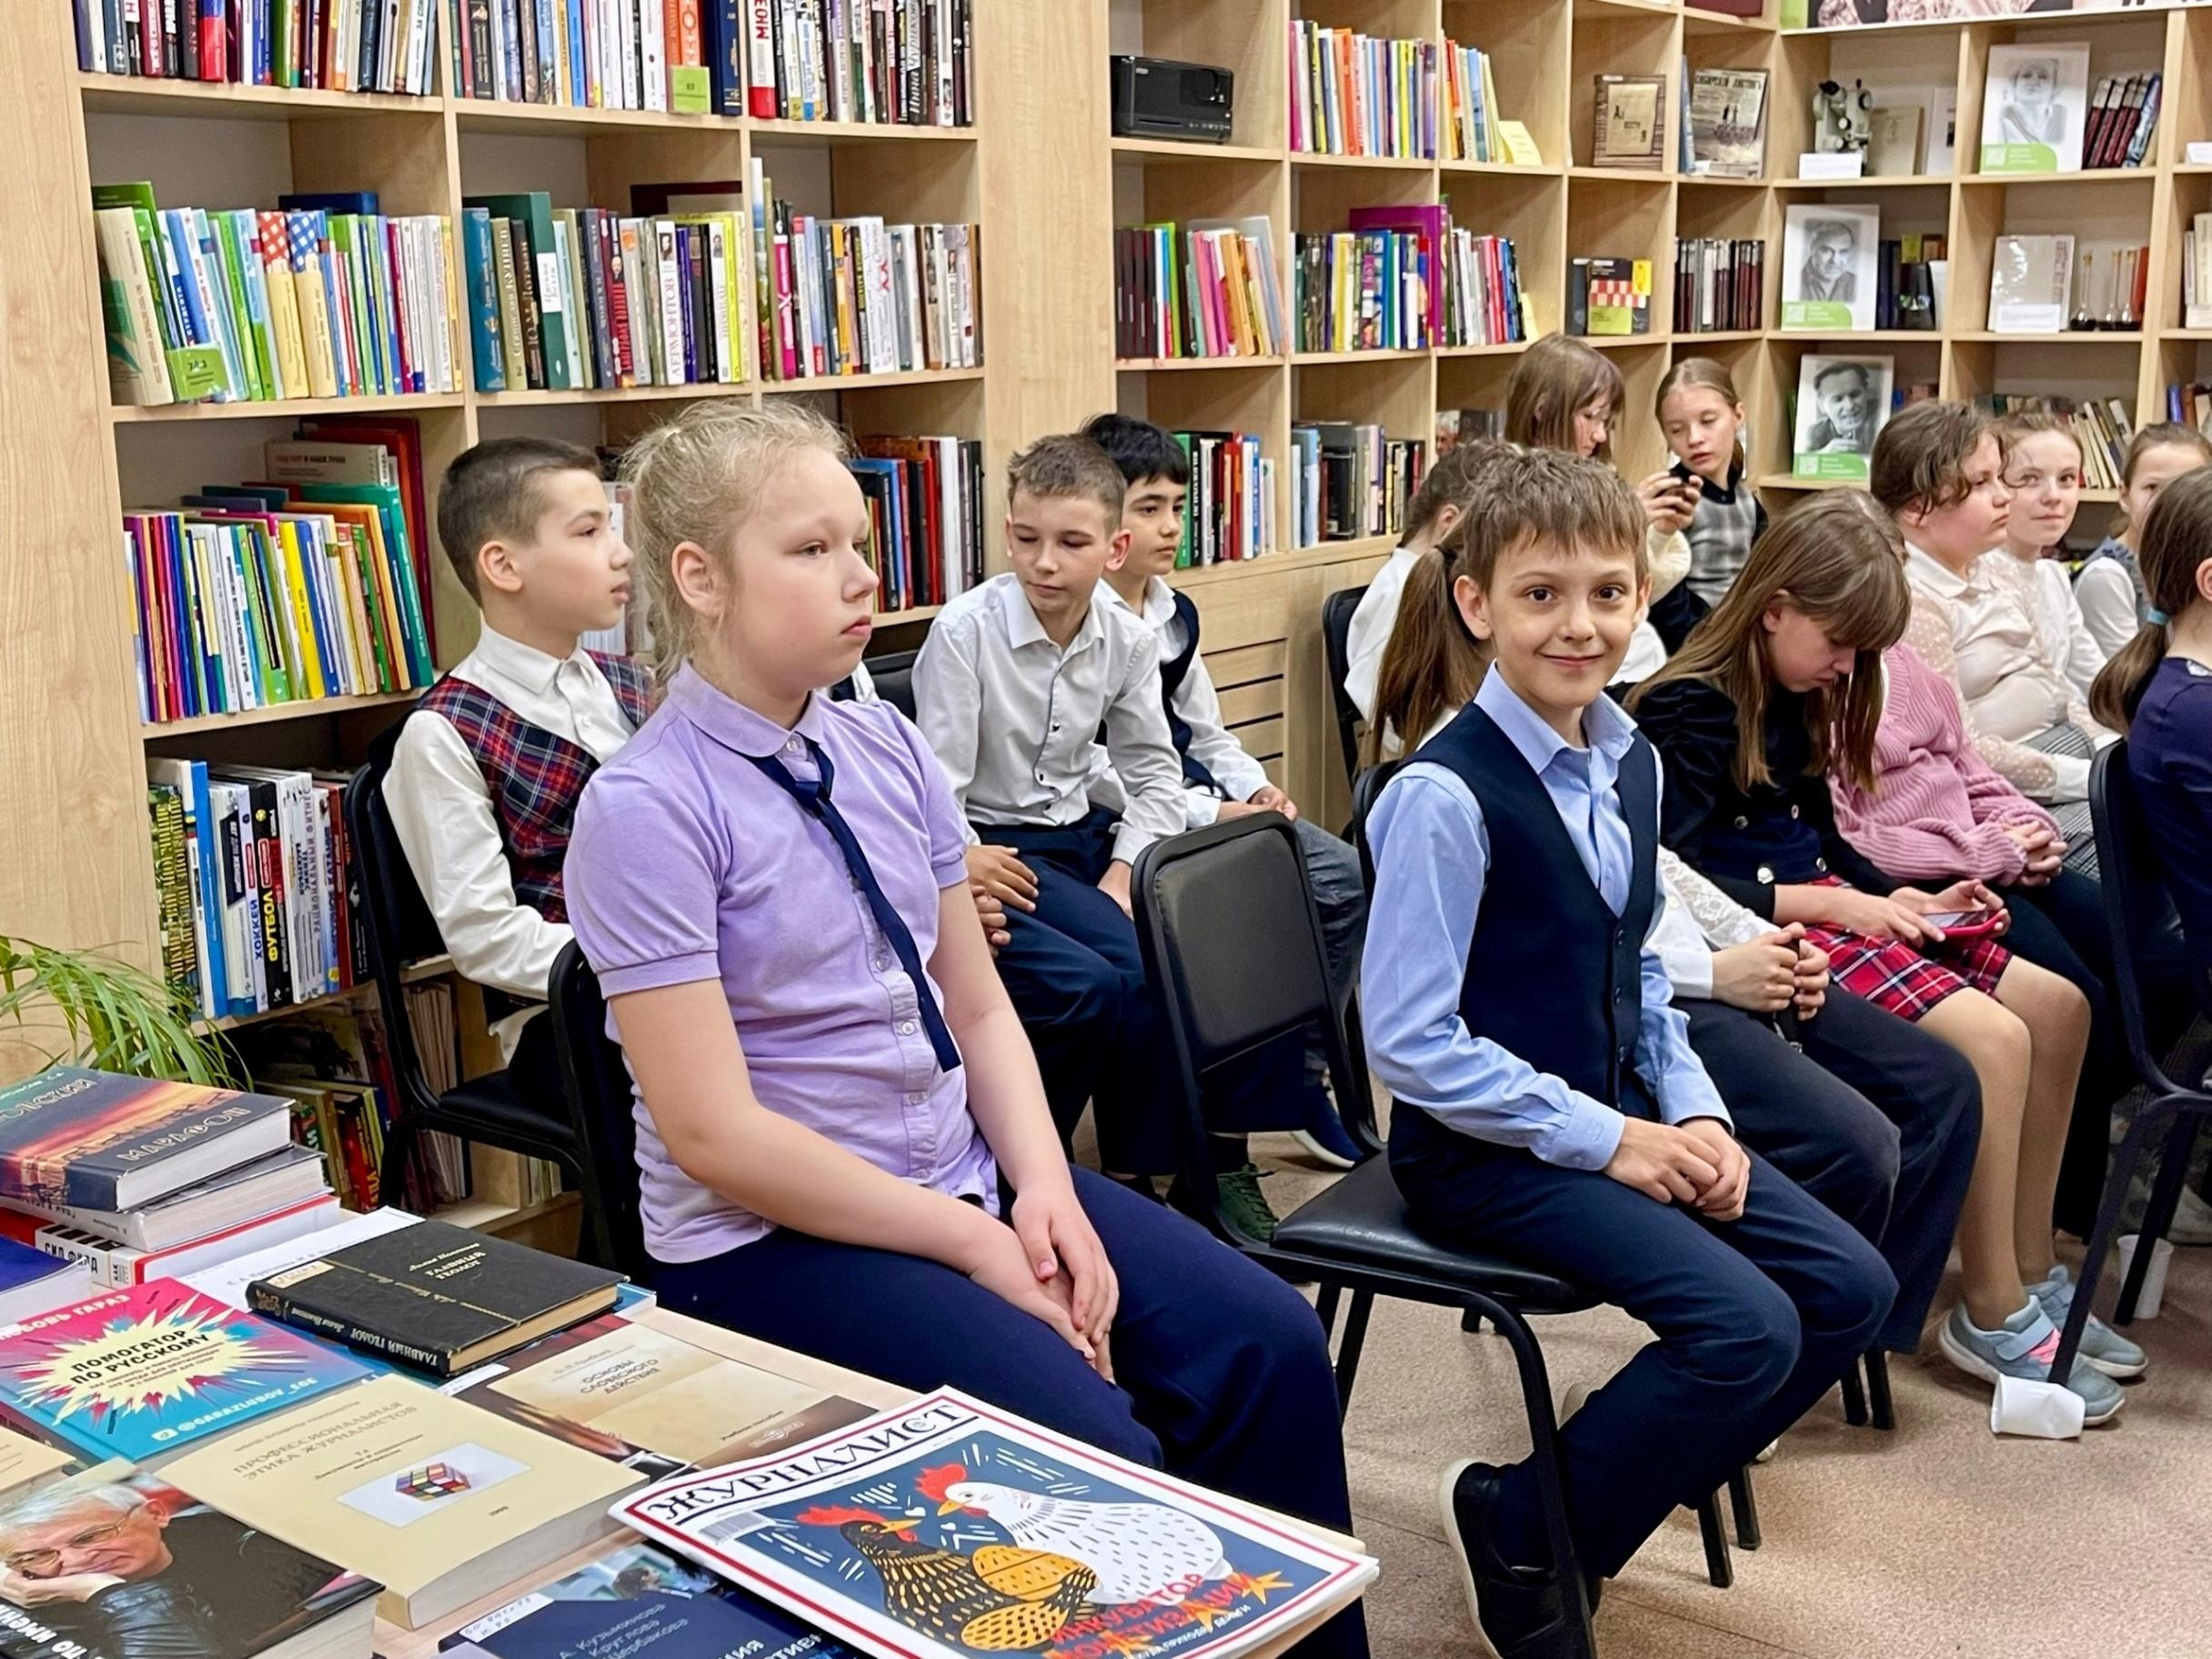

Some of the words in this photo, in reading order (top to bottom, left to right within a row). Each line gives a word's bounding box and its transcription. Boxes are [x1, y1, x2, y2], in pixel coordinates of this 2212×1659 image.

[662, 276, 683, 377] ЛЕРМОНТОВ
[516, 366, 523, 377] 2
[302, 850, 312, 894] ТЕННИС
[309, 839, 322, 934] РАЦИОНАЛЬНЫЙ
[248, 900, 264, 960] ХОККЕЙ
[262, 890, 279, 962] ФУТБОЛ
[116, 1106, 252, 1161] МАРАФОН
[73, 1292, 131, 1318] ГАРАЗ
[71, 1367, 102, 1384] ПО
[105, 1333, 211, 1373] РУССКОМУ
[72, 1331, 187, 1372] ПОМОГАТОР
[350, 1327, 387, 1352] ГЕОЛОГ
[387, 1338, 439, 1367] ГЛАВНЫЙ
[580, 1358, 659, 1395] СЛОВЕСНОГО
[582, 1360, 634, 1383] ОСНОВЫ
[605, 1367, 660, 1395] ДЕЙСТВИЯ
[233, 1402, 404, 1474] ПРОФЕССИОНАЛЬНАЯ
[243, 1453, 301, 1482] ЭТИКА
[303, 1406, 418, 1454] ЖУРНАЛИСТОВ
[648, 1404, 962, 1521] ЖУРНАЛИСТ
